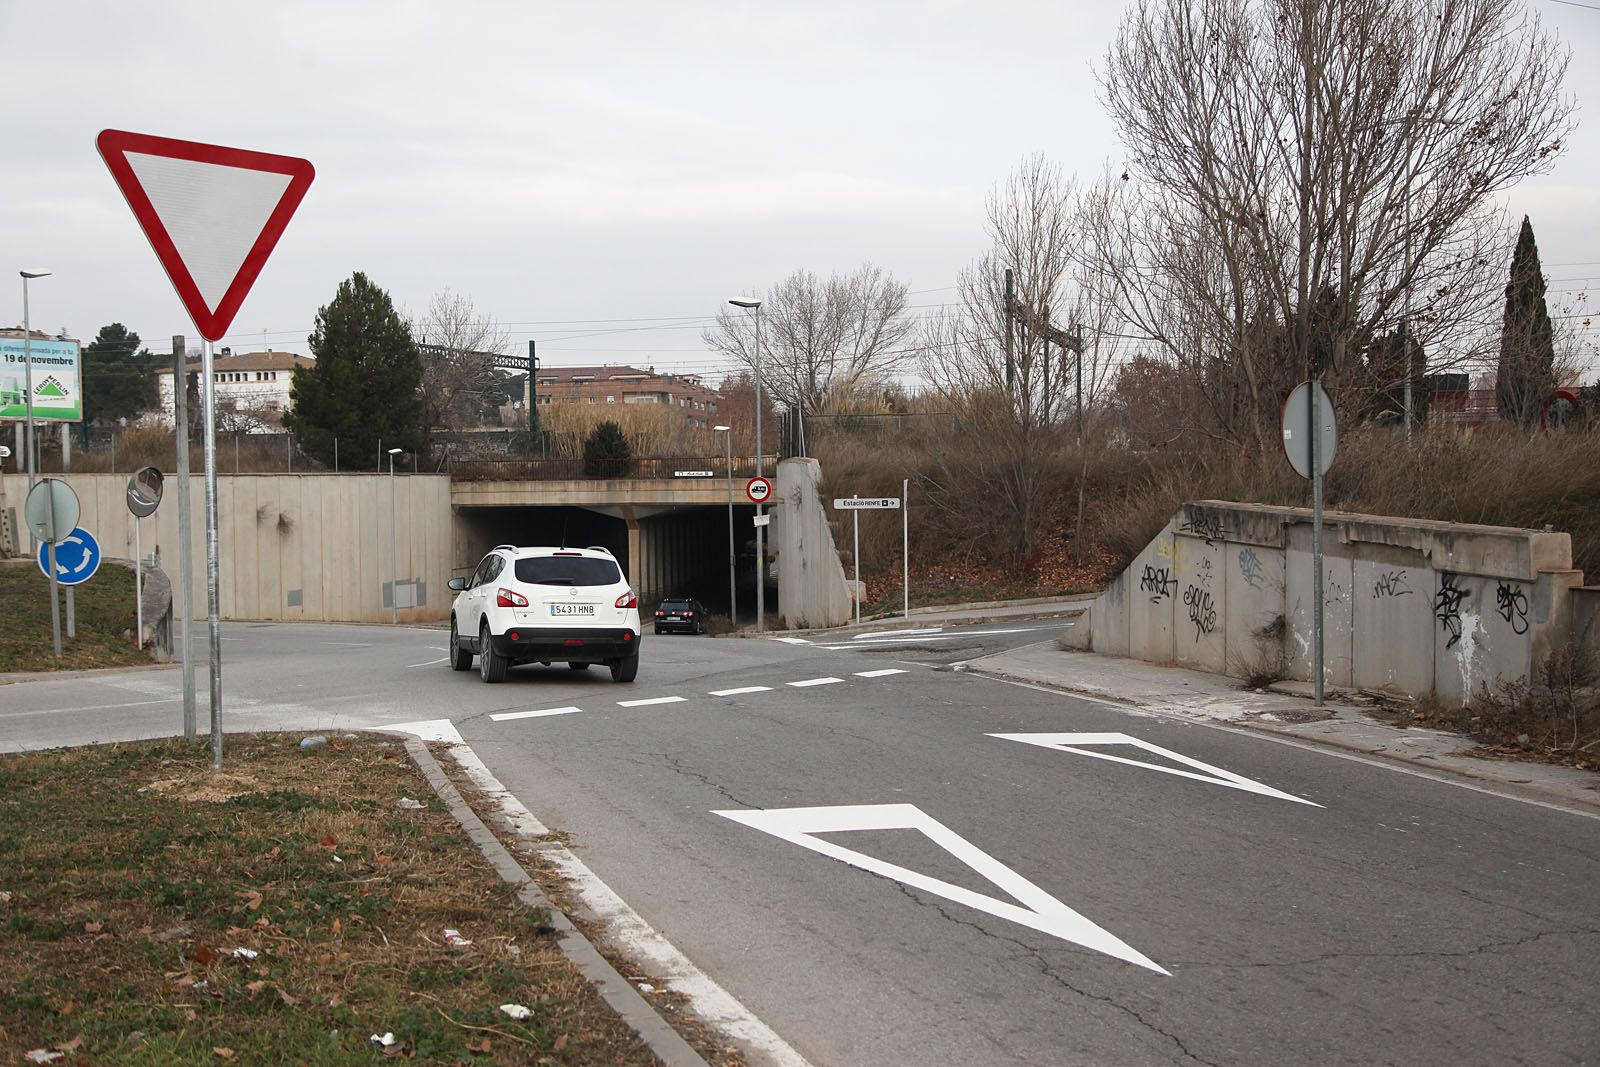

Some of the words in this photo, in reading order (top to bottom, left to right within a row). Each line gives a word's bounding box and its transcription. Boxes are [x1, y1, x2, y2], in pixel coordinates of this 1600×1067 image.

[4, 354, 15, 362] 19
[31, 356, 74, 365] novembre
[33, 379, 50, 395] LEROY
[48, 375, 70, 396] MERLIN
[556, 605, 577, 614] 5431
[578, 605, 594, 614] HNB
